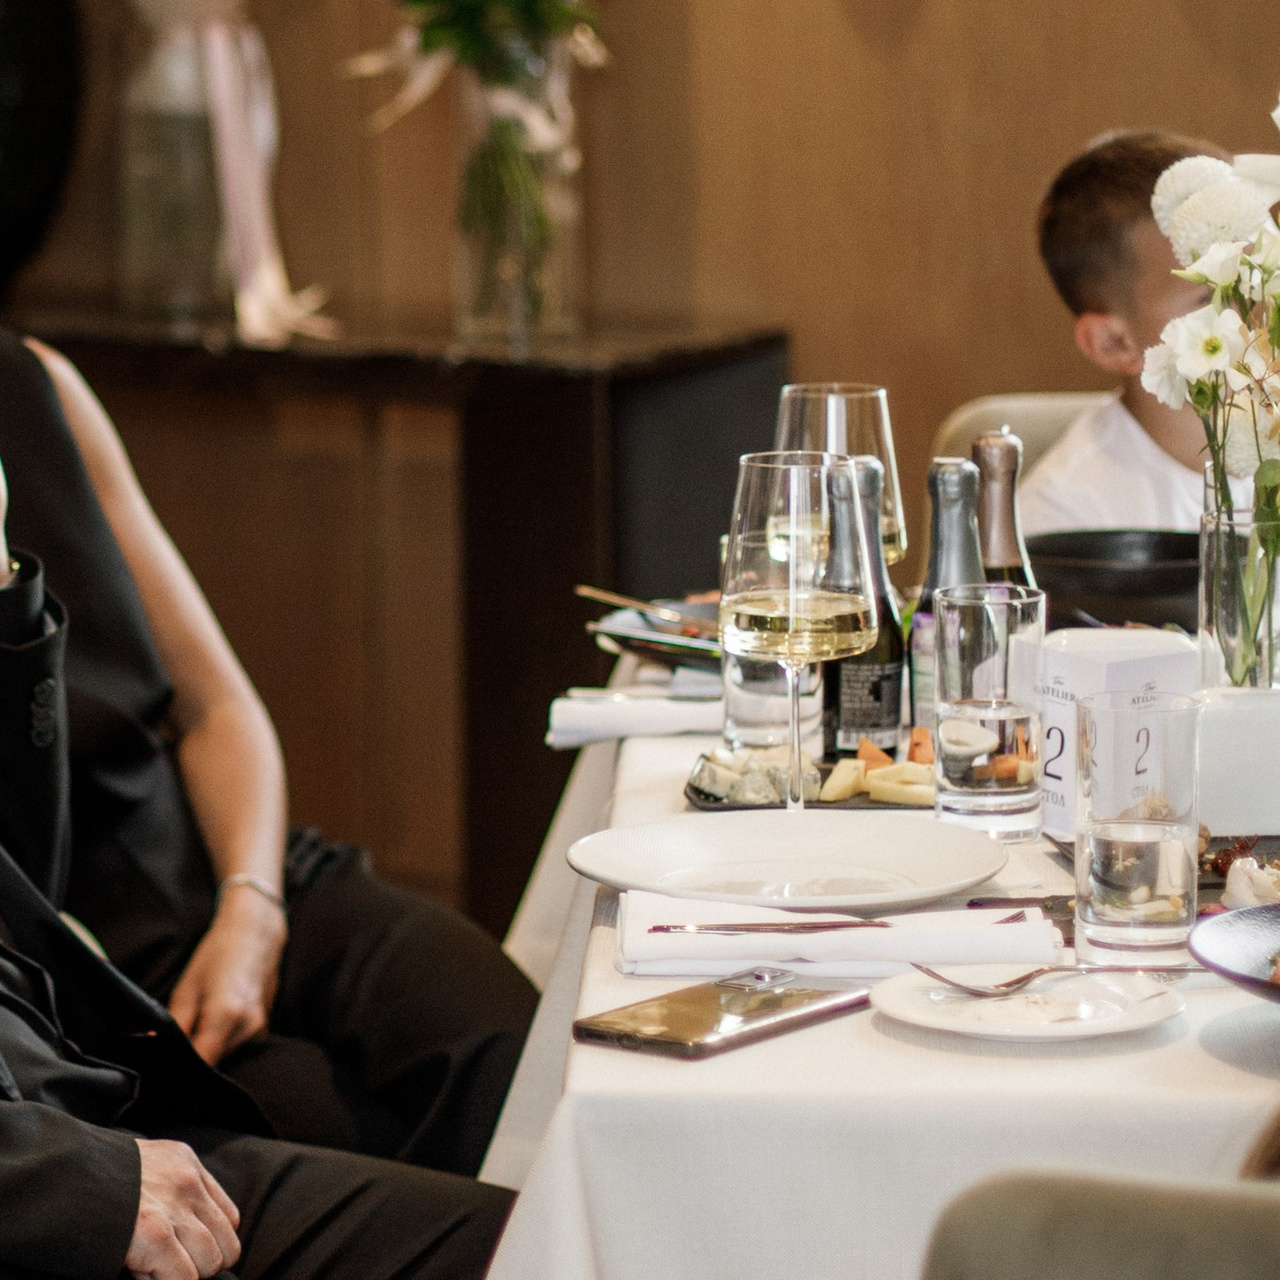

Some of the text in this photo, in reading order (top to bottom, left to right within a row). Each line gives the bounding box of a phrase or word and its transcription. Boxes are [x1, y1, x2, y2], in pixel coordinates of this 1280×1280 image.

[1043, 726, 1065, 781] 2
[1135, 727, 1150, 775] 2
[1040, 788, 1066, 808] ТОЛ
